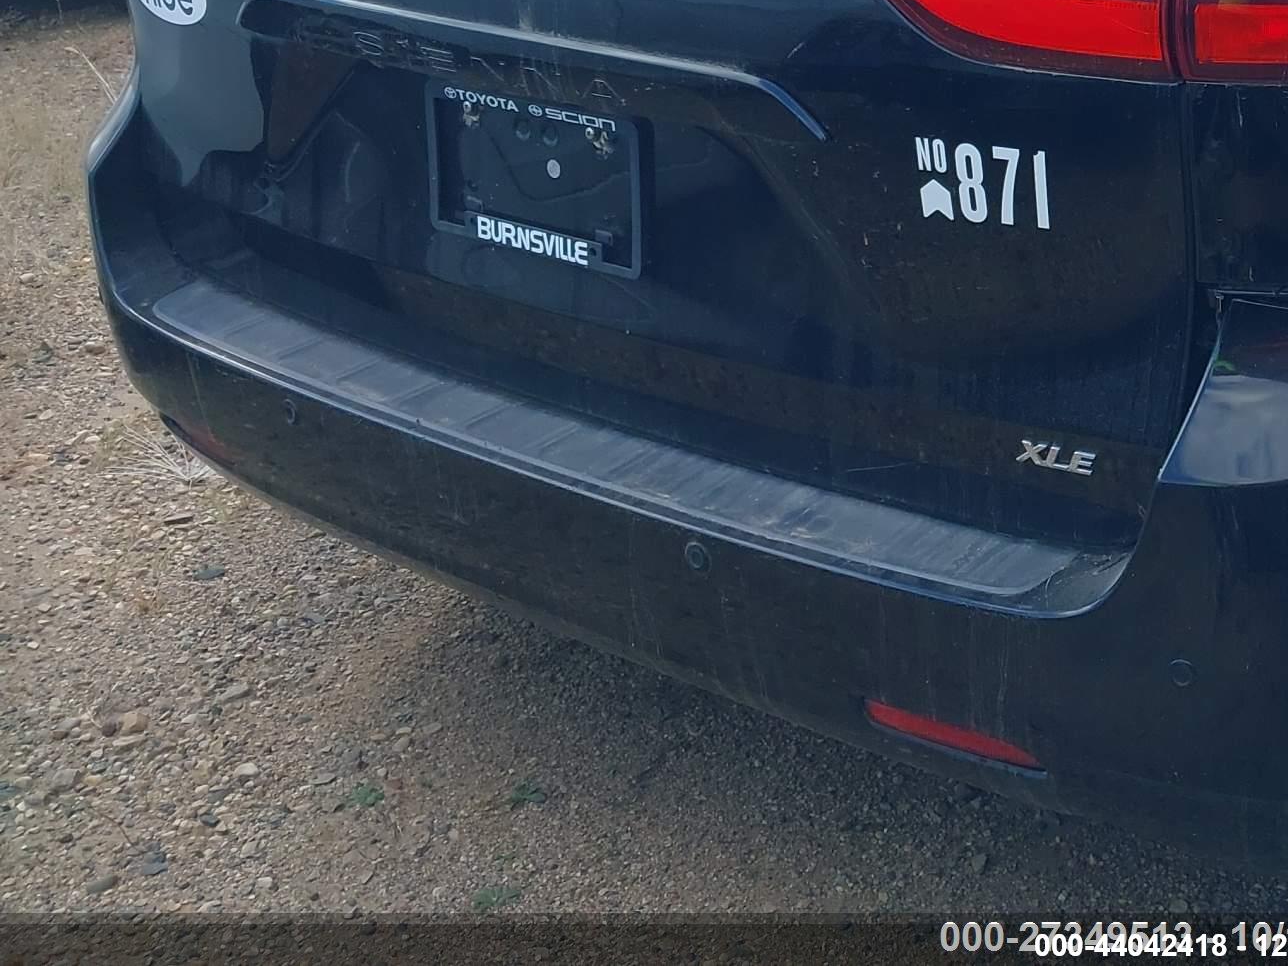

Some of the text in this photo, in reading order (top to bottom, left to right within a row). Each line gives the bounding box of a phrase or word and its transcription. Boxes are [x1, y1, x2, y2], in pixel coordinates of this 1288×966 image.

[455, 88, 520, 113] TOYOTA
[914, 136, 1051, 230] NO 871
[477, 215, 589, 266] BURNSVILLE
[1015, 439, 1096, 476] XLE
